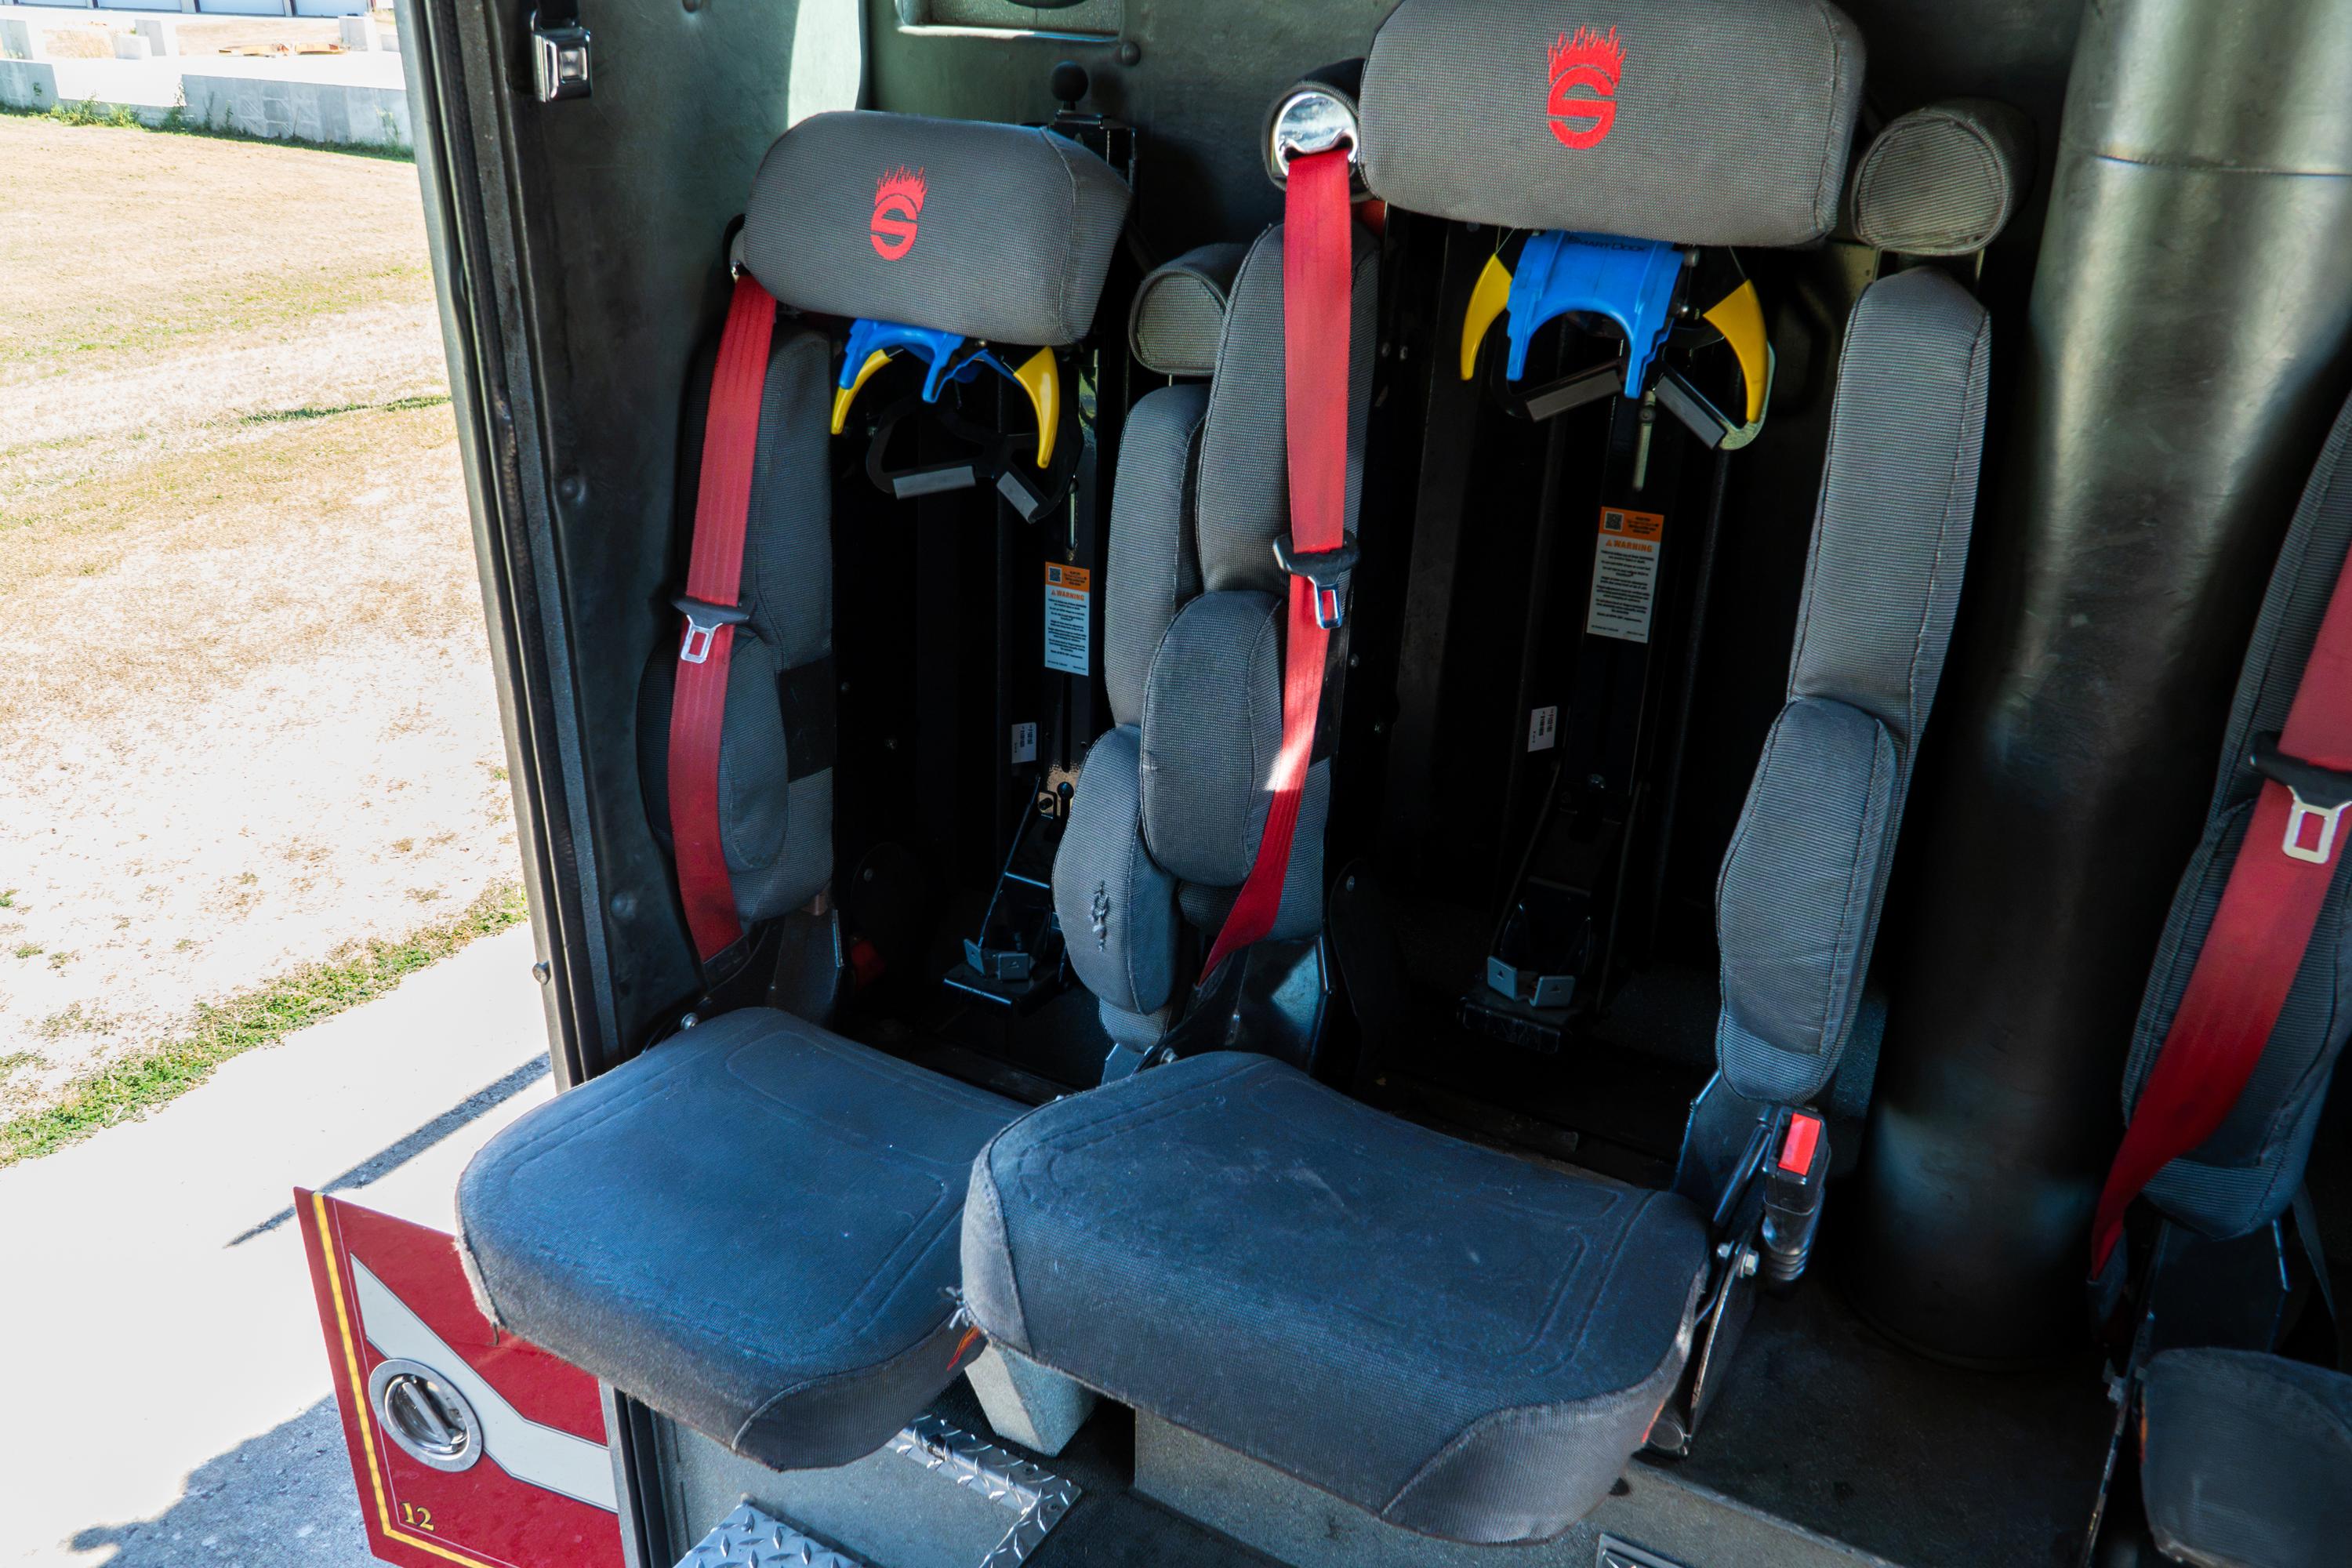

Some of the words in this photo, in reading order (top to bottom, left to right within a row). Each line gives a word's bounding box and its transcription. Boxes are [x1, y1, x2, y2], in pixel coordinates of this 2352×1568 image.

[1614, 539, 1653, 553] WARNING
[1057, 590, 1085, 601] WARNING
[401, 1501, 434, 1531] 12
